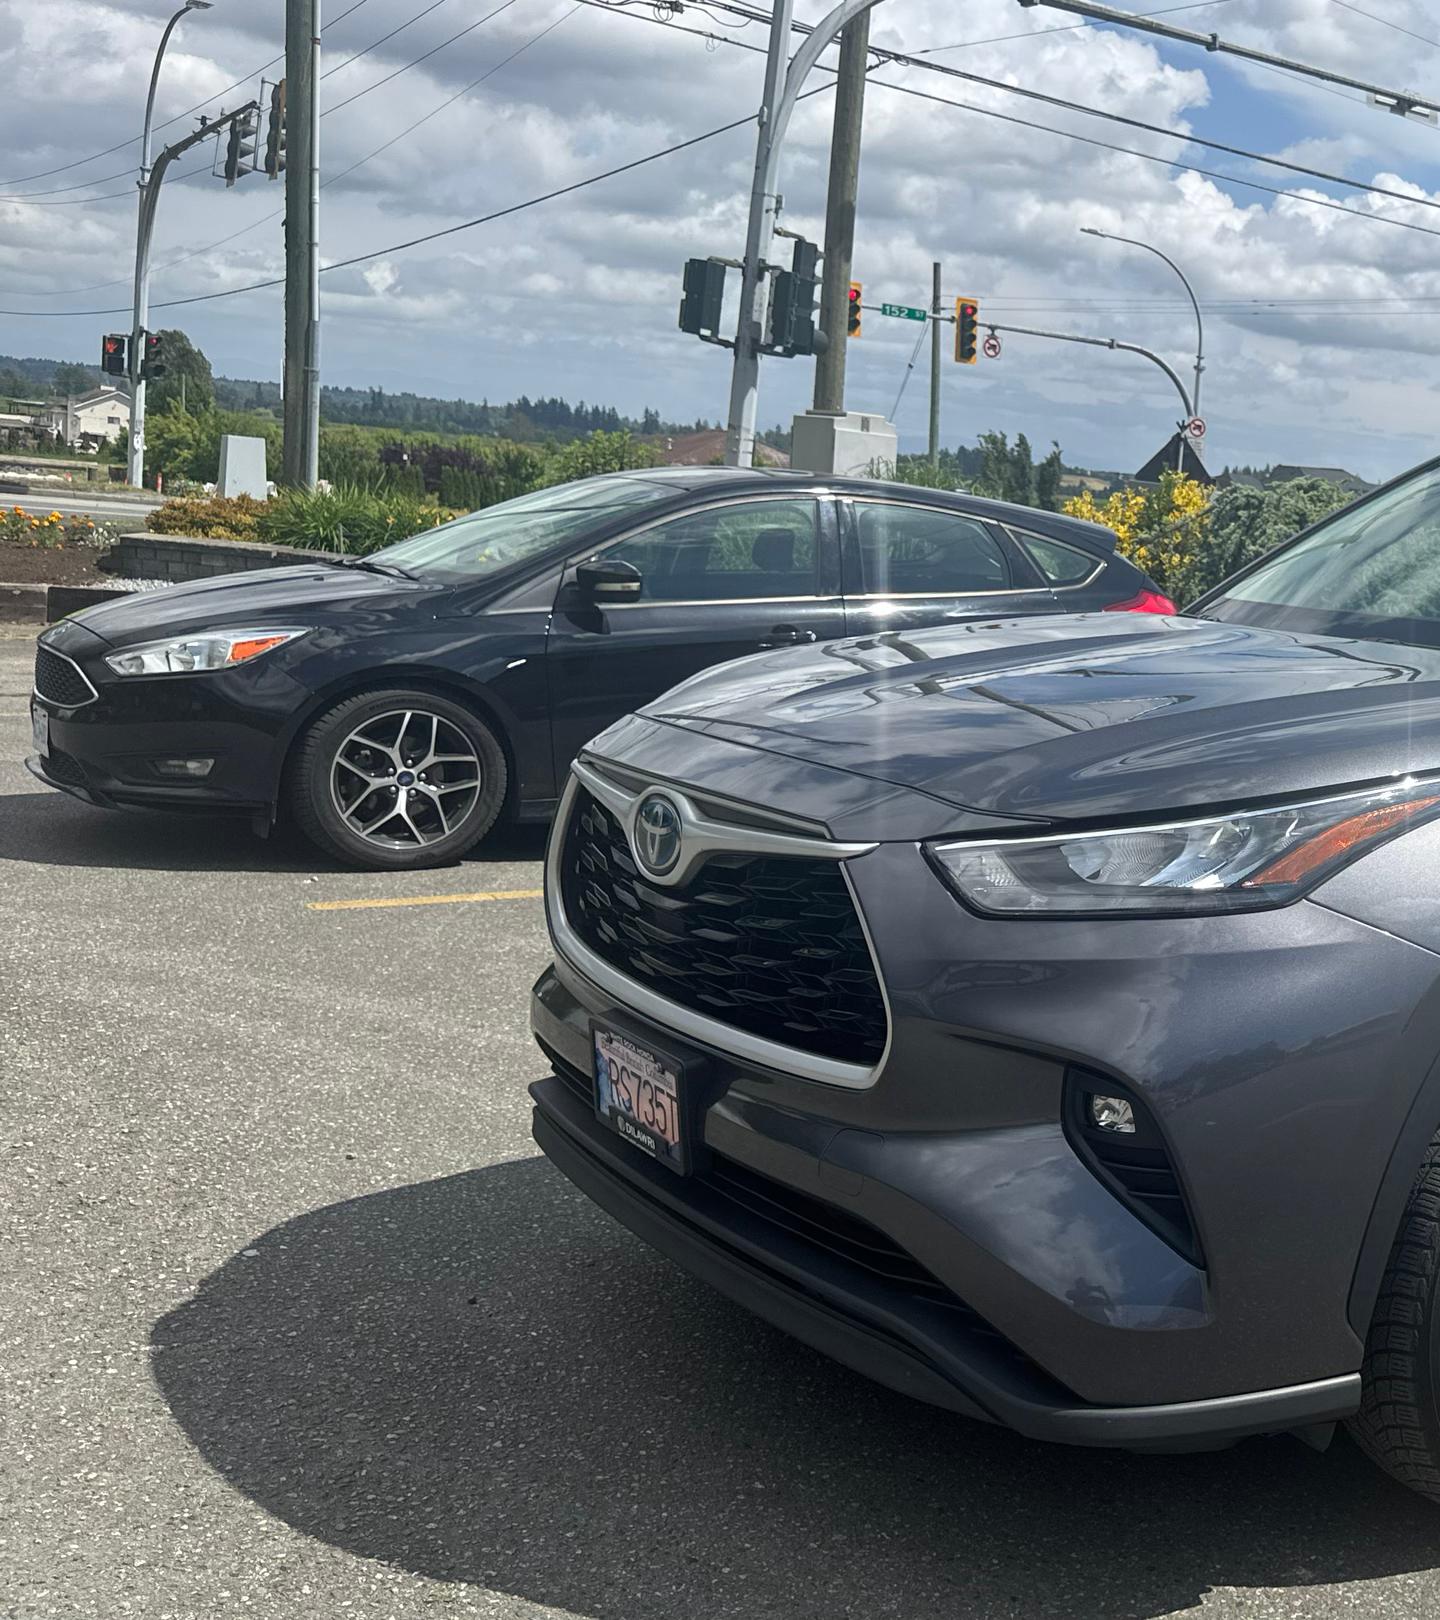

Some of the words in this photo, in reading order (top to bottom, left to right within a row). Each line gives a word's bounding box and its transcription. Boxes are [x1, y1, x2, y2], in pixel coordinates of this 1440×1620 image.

[884, 305, 909, 318] 152
[915, 310, 925, 319] ST
[608, 1056, 679, 1143] RS735T
